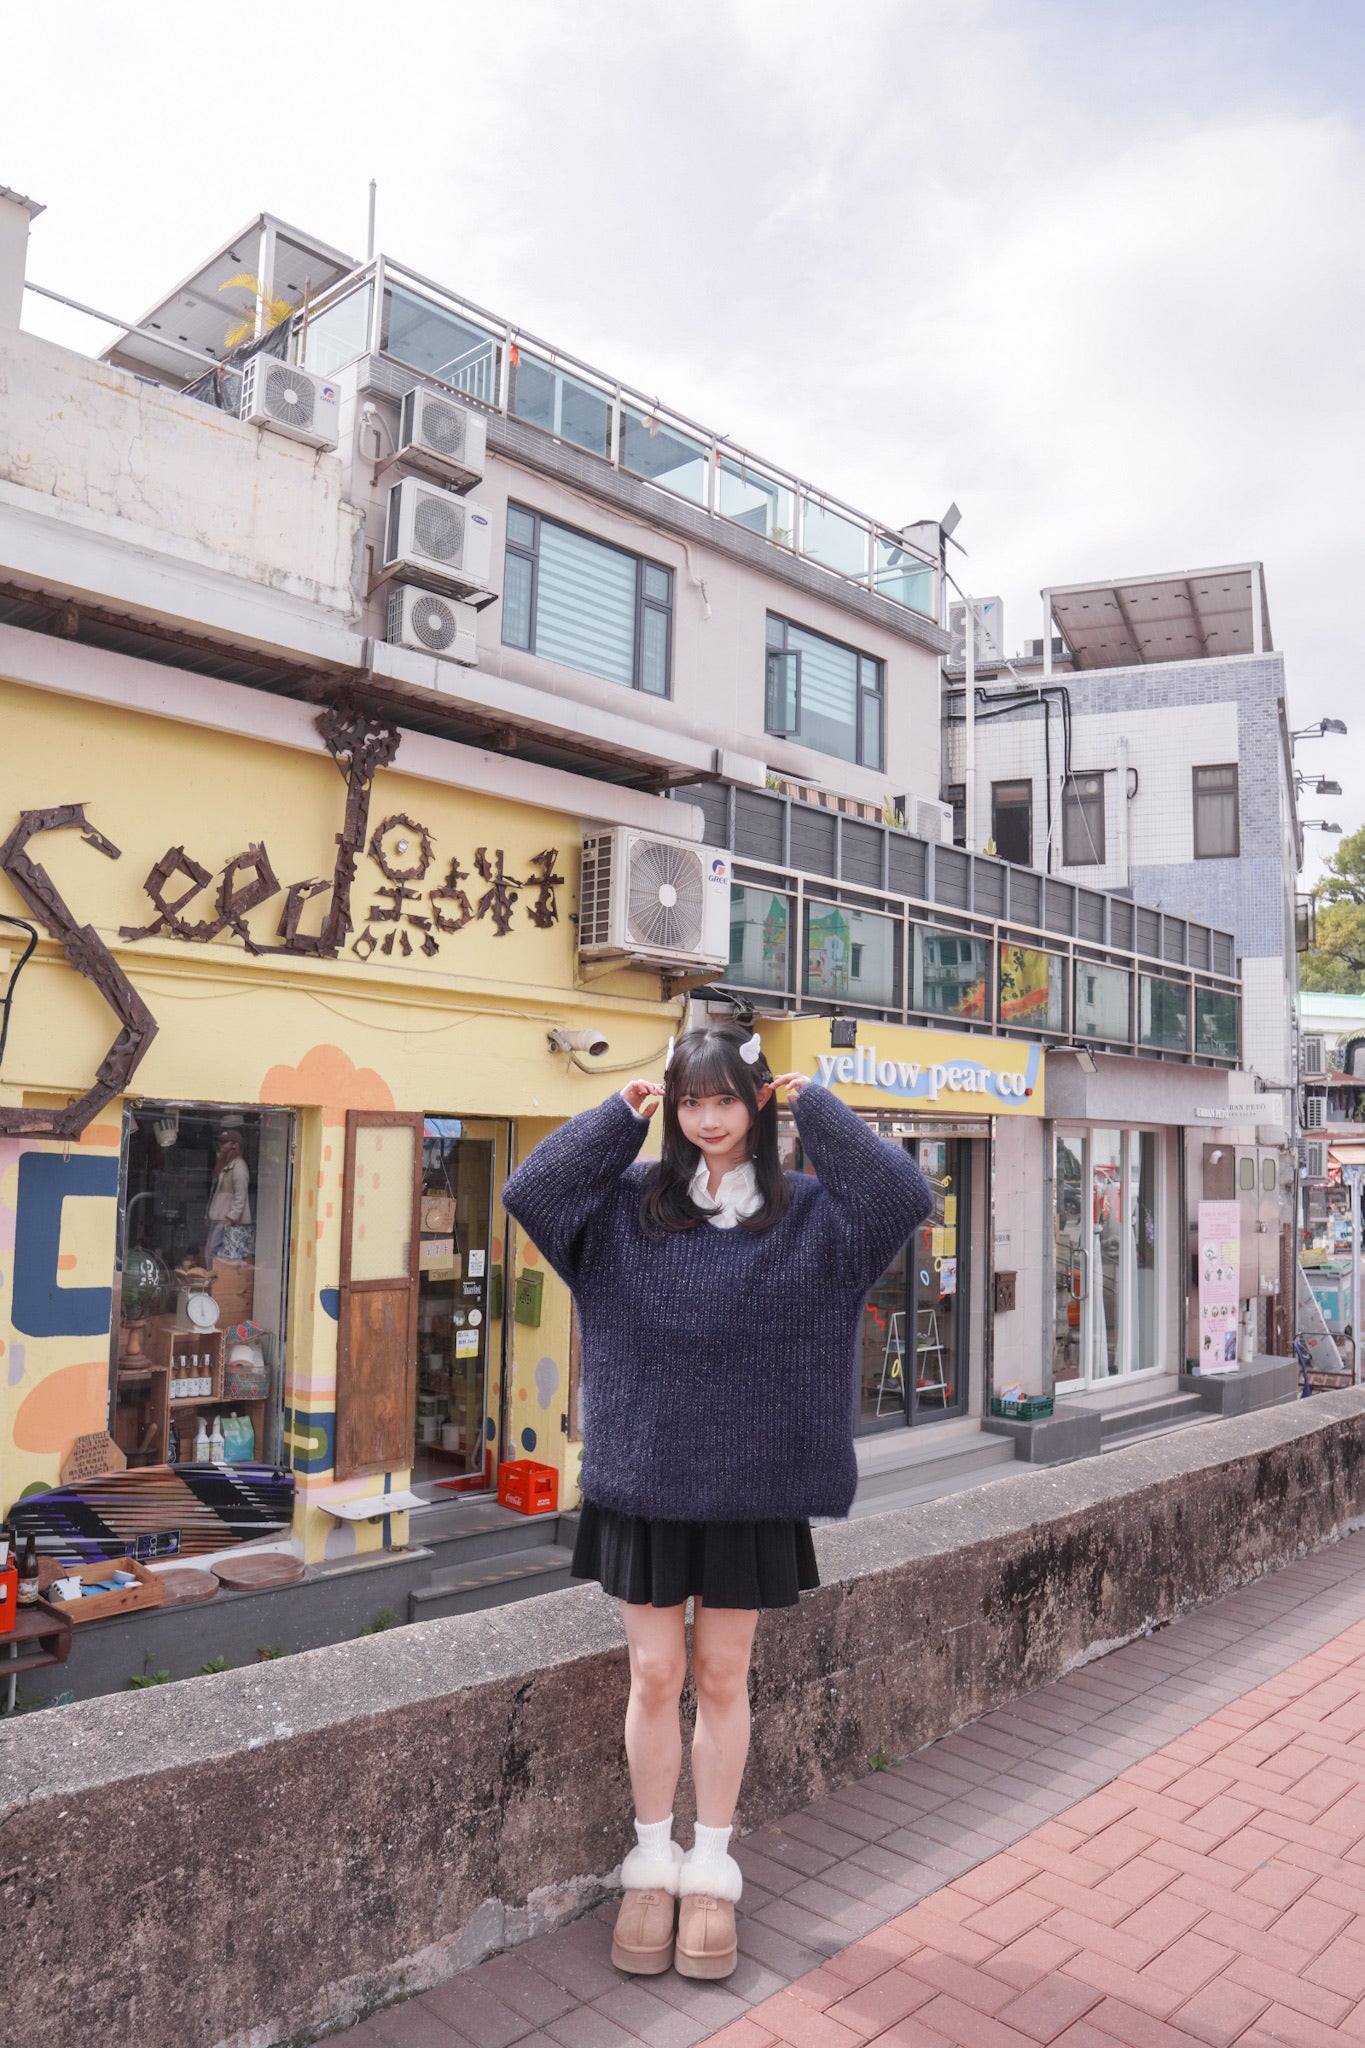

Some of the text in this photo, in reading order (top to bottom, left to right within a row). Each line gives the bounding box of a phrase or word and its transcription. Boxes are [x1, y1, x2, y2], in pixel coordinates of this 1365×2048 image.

[708, 874, 728, 885] GREE
[0, 703, 402, 1141] Seed
[816, 1045, 921, 1089] yellow
[926, 1063, 991, 1101] pear
